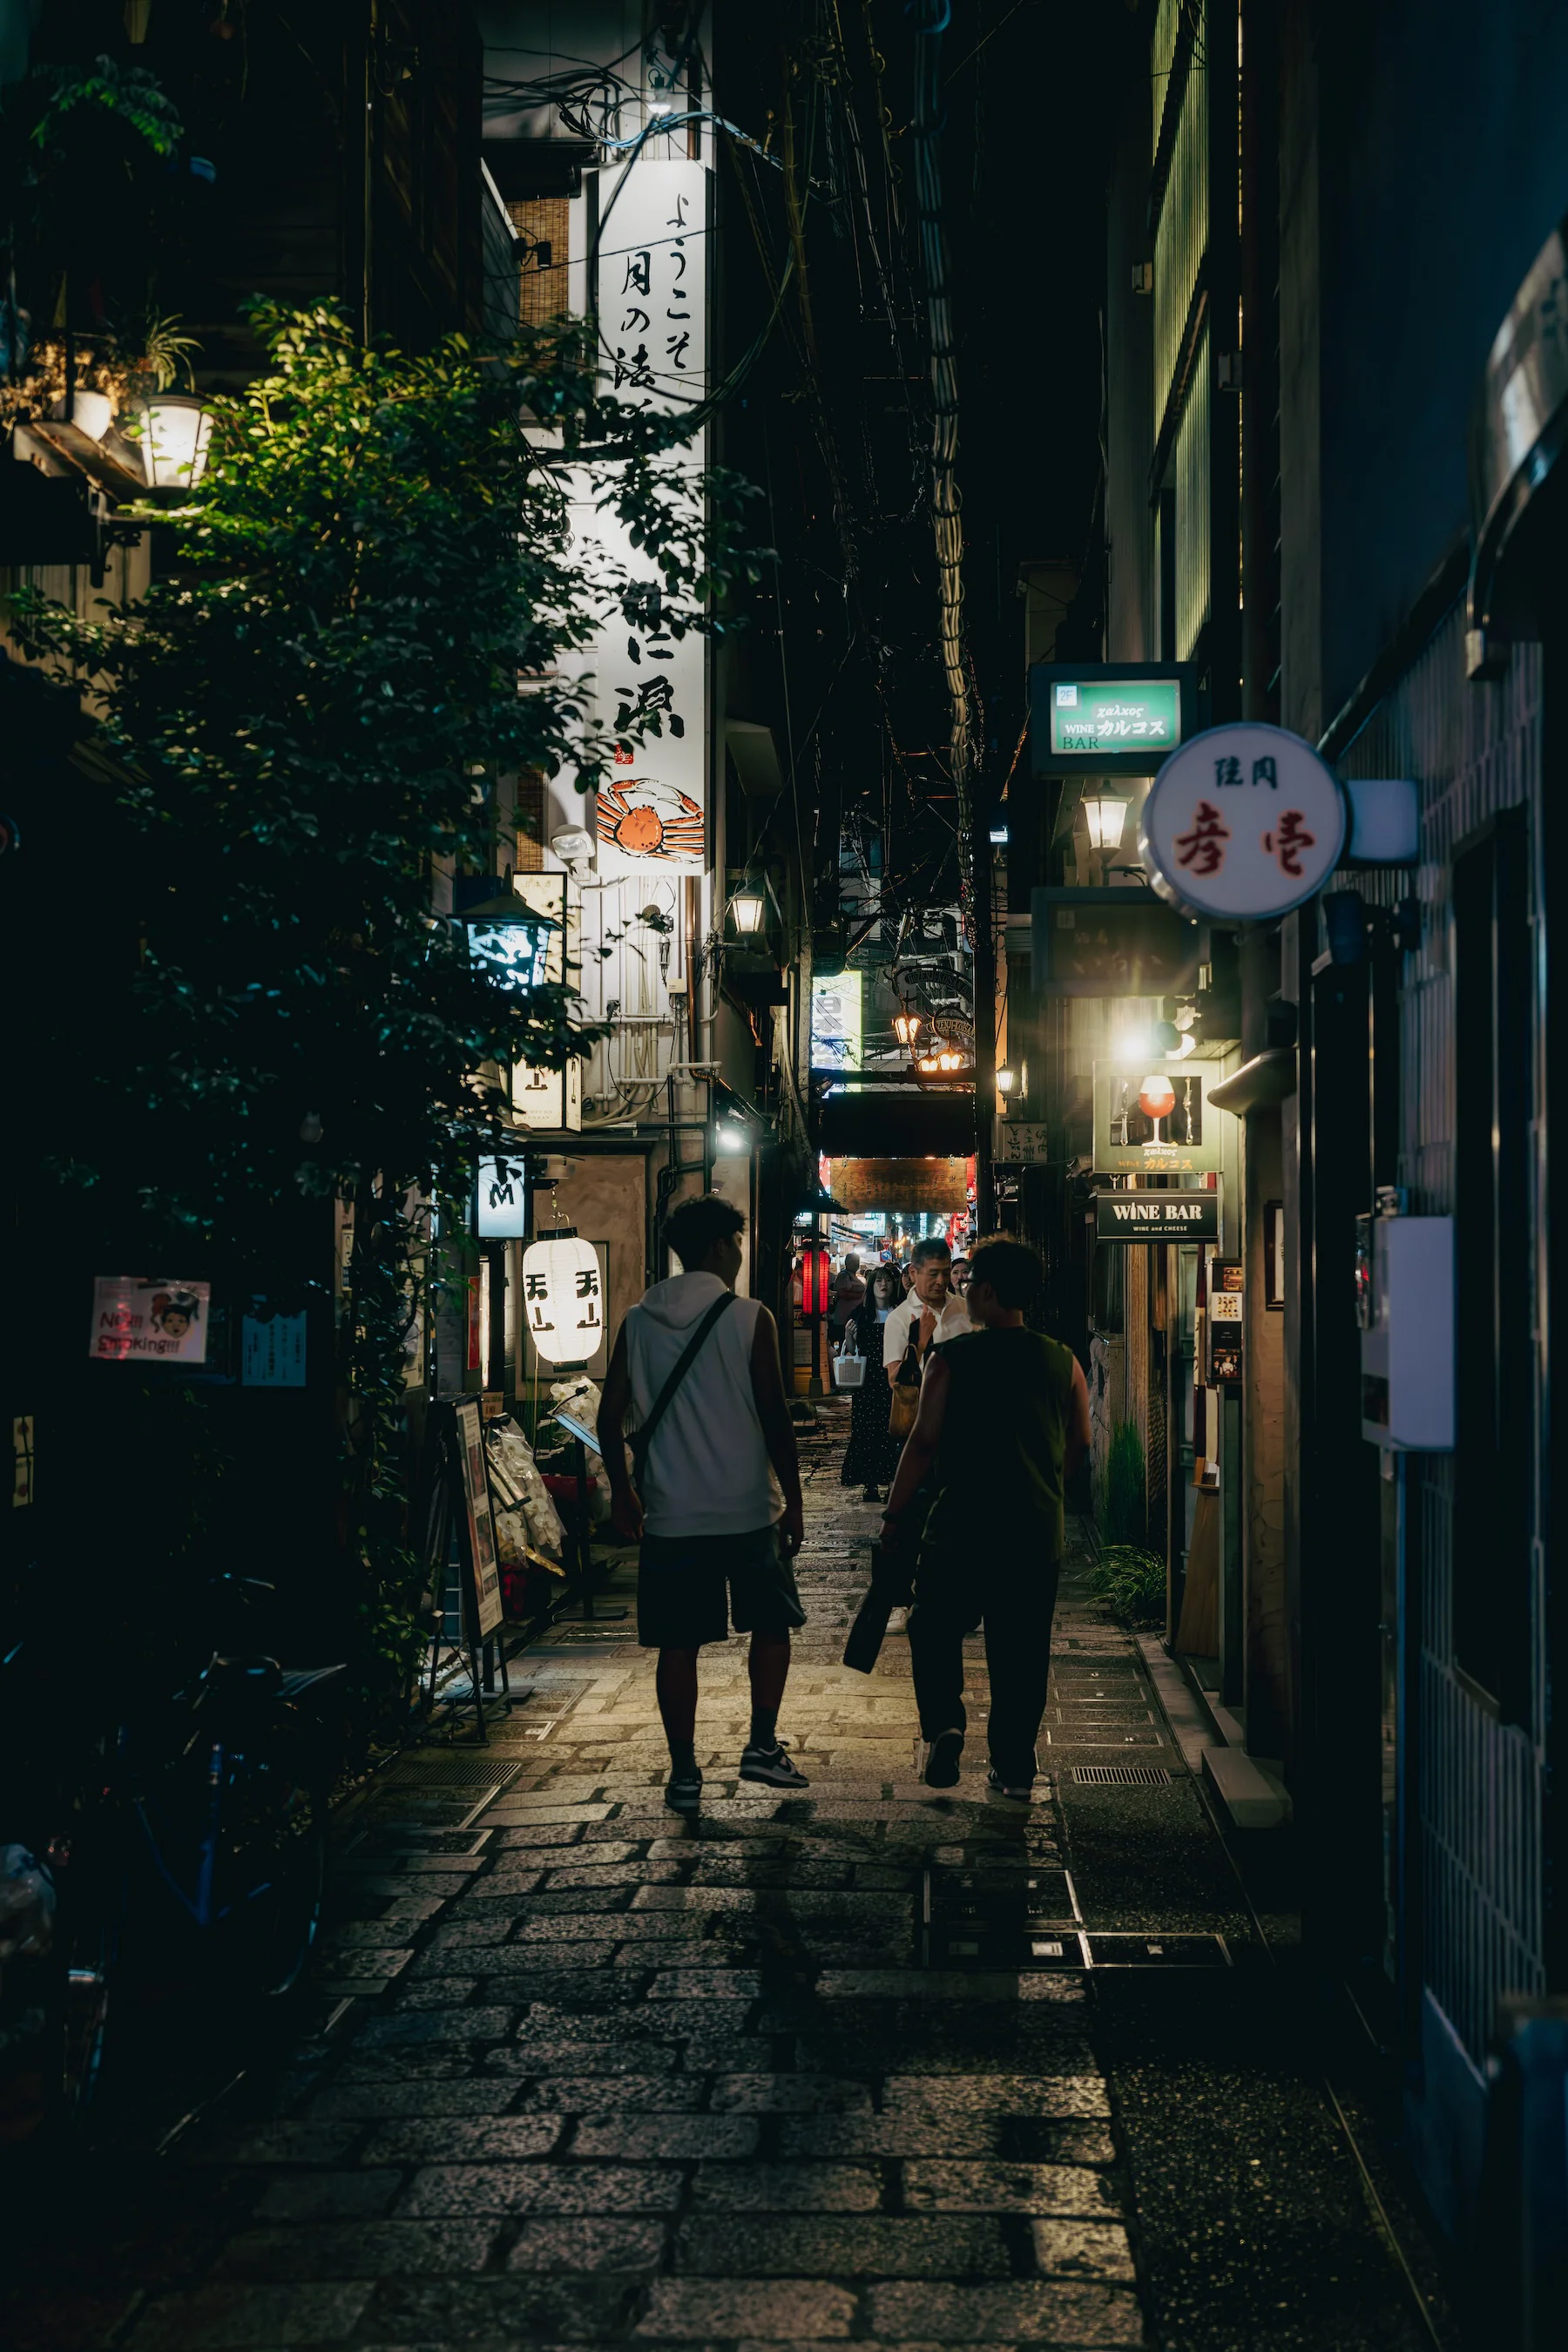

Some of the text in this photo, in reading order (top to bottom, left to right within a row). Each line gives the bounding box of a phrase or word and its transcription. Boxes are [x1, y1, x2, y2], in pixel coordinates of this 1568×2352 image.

[666, 193, 691, 369] ようこそ
[614, 251, 655, 416] 月の法
[1059, 690, 1073, 702] 2F
[1064, 720, 1166, 737] WINE カルコス
[1062, 736, 1100, 750] BAR
[1144, 1158, 1193, 1170] カルコス
[1165, 1205, 1203, 1220] BAR
